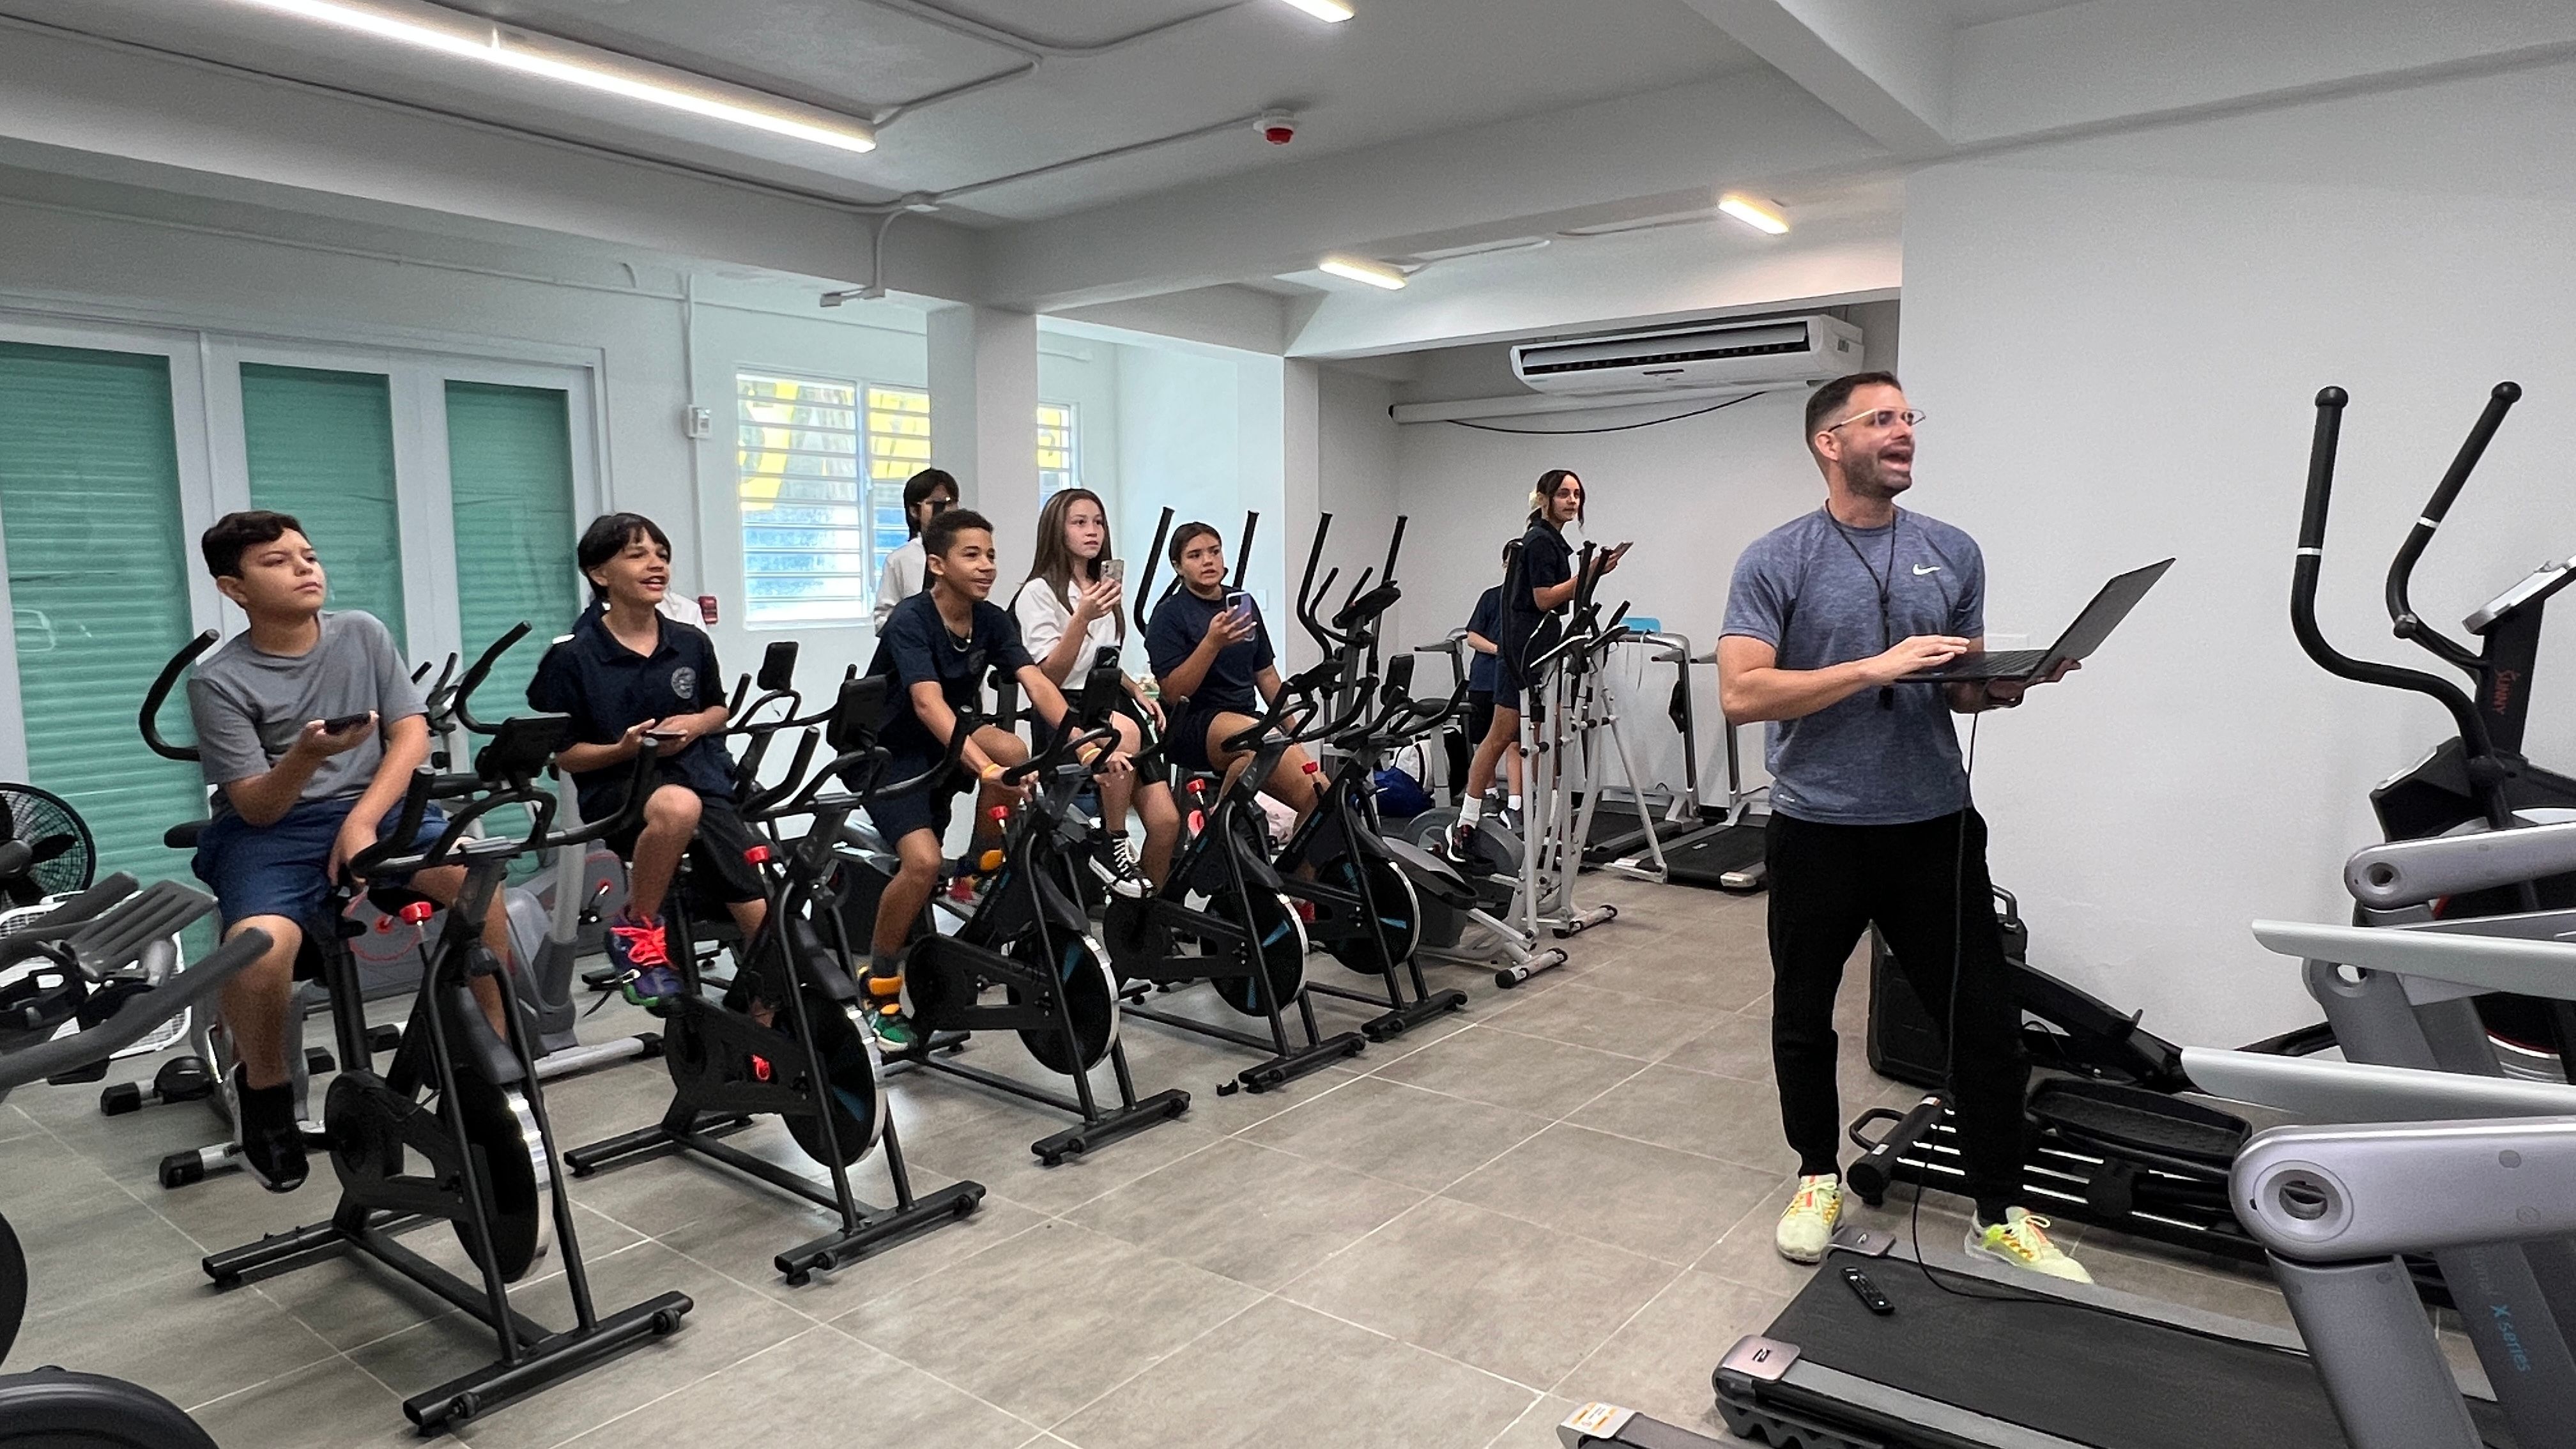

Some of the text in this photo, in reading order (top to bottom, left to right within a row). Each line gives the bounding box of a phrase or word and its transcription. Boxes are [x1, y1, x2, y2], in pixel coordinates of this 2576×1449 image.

[2494, 668, 2519, 715] SUNNY
[2490, 1305, 2531, 1372] X series
